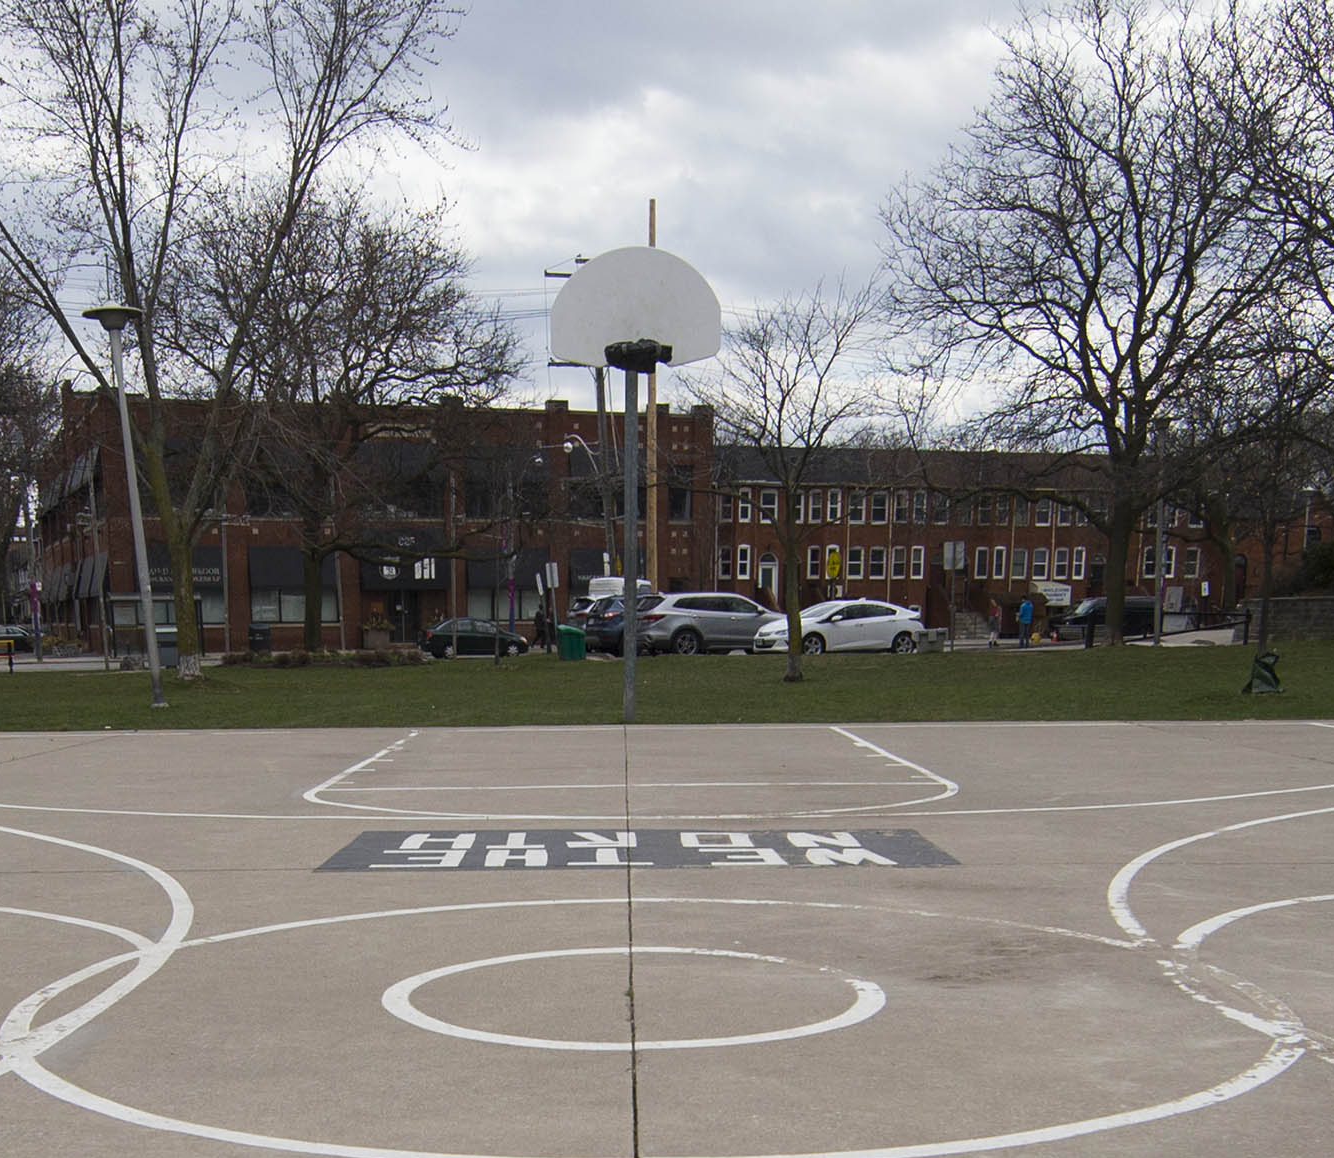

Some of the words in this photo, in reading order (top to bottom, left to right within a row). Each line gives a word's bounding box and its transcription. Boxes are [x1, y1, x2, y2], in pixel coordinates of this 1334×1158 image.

[398, 831, 862, 850] NORTH
[369, 847, 655, 868] THE
[698, 847, 899, 866] WE
